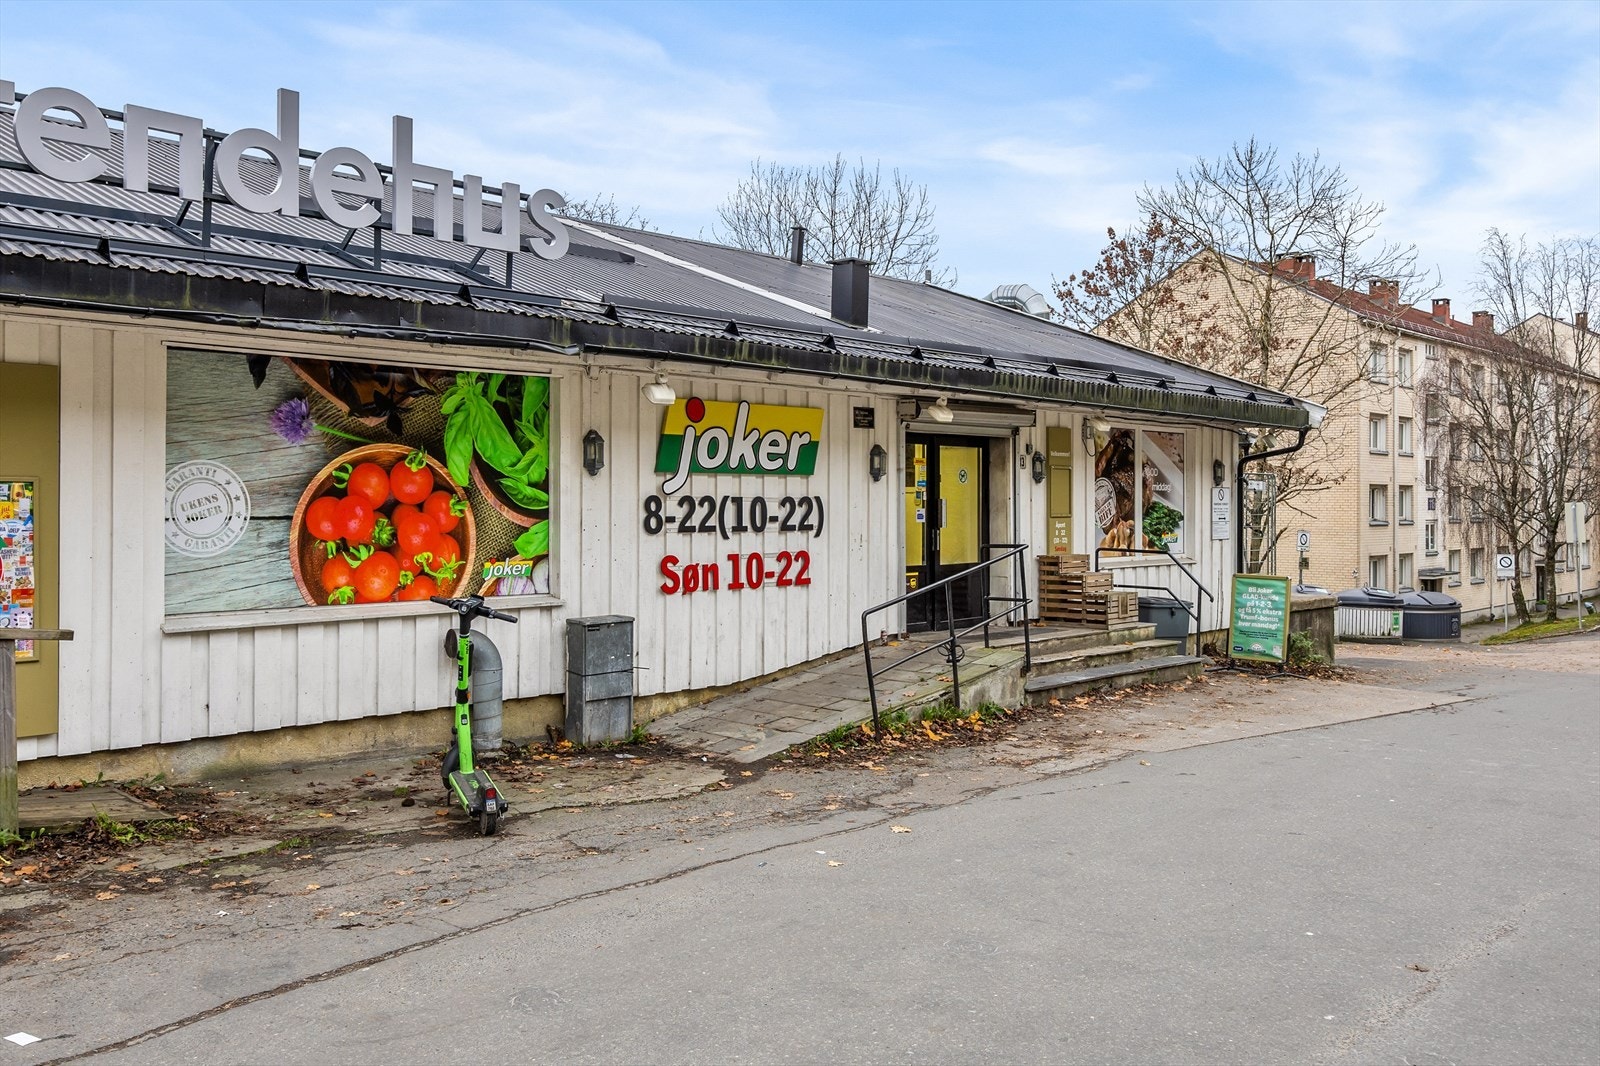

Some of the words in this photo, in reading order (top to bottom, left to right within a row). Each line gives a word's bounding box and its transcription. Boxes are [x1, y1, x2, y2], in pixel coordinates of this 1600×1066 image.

[662, 397, 812, 495] joker
[166, 467, 217, 492] GARANTI
[180, 494, 219, 512] UKENS
[185, 505, 223, 524] JOKER
[184, 527, 235, 550] GARANTI
[484, 557, 529, 581] joker
[660, 554, 720, 596] Søn
[727, 550, 812, 591] 10-22
